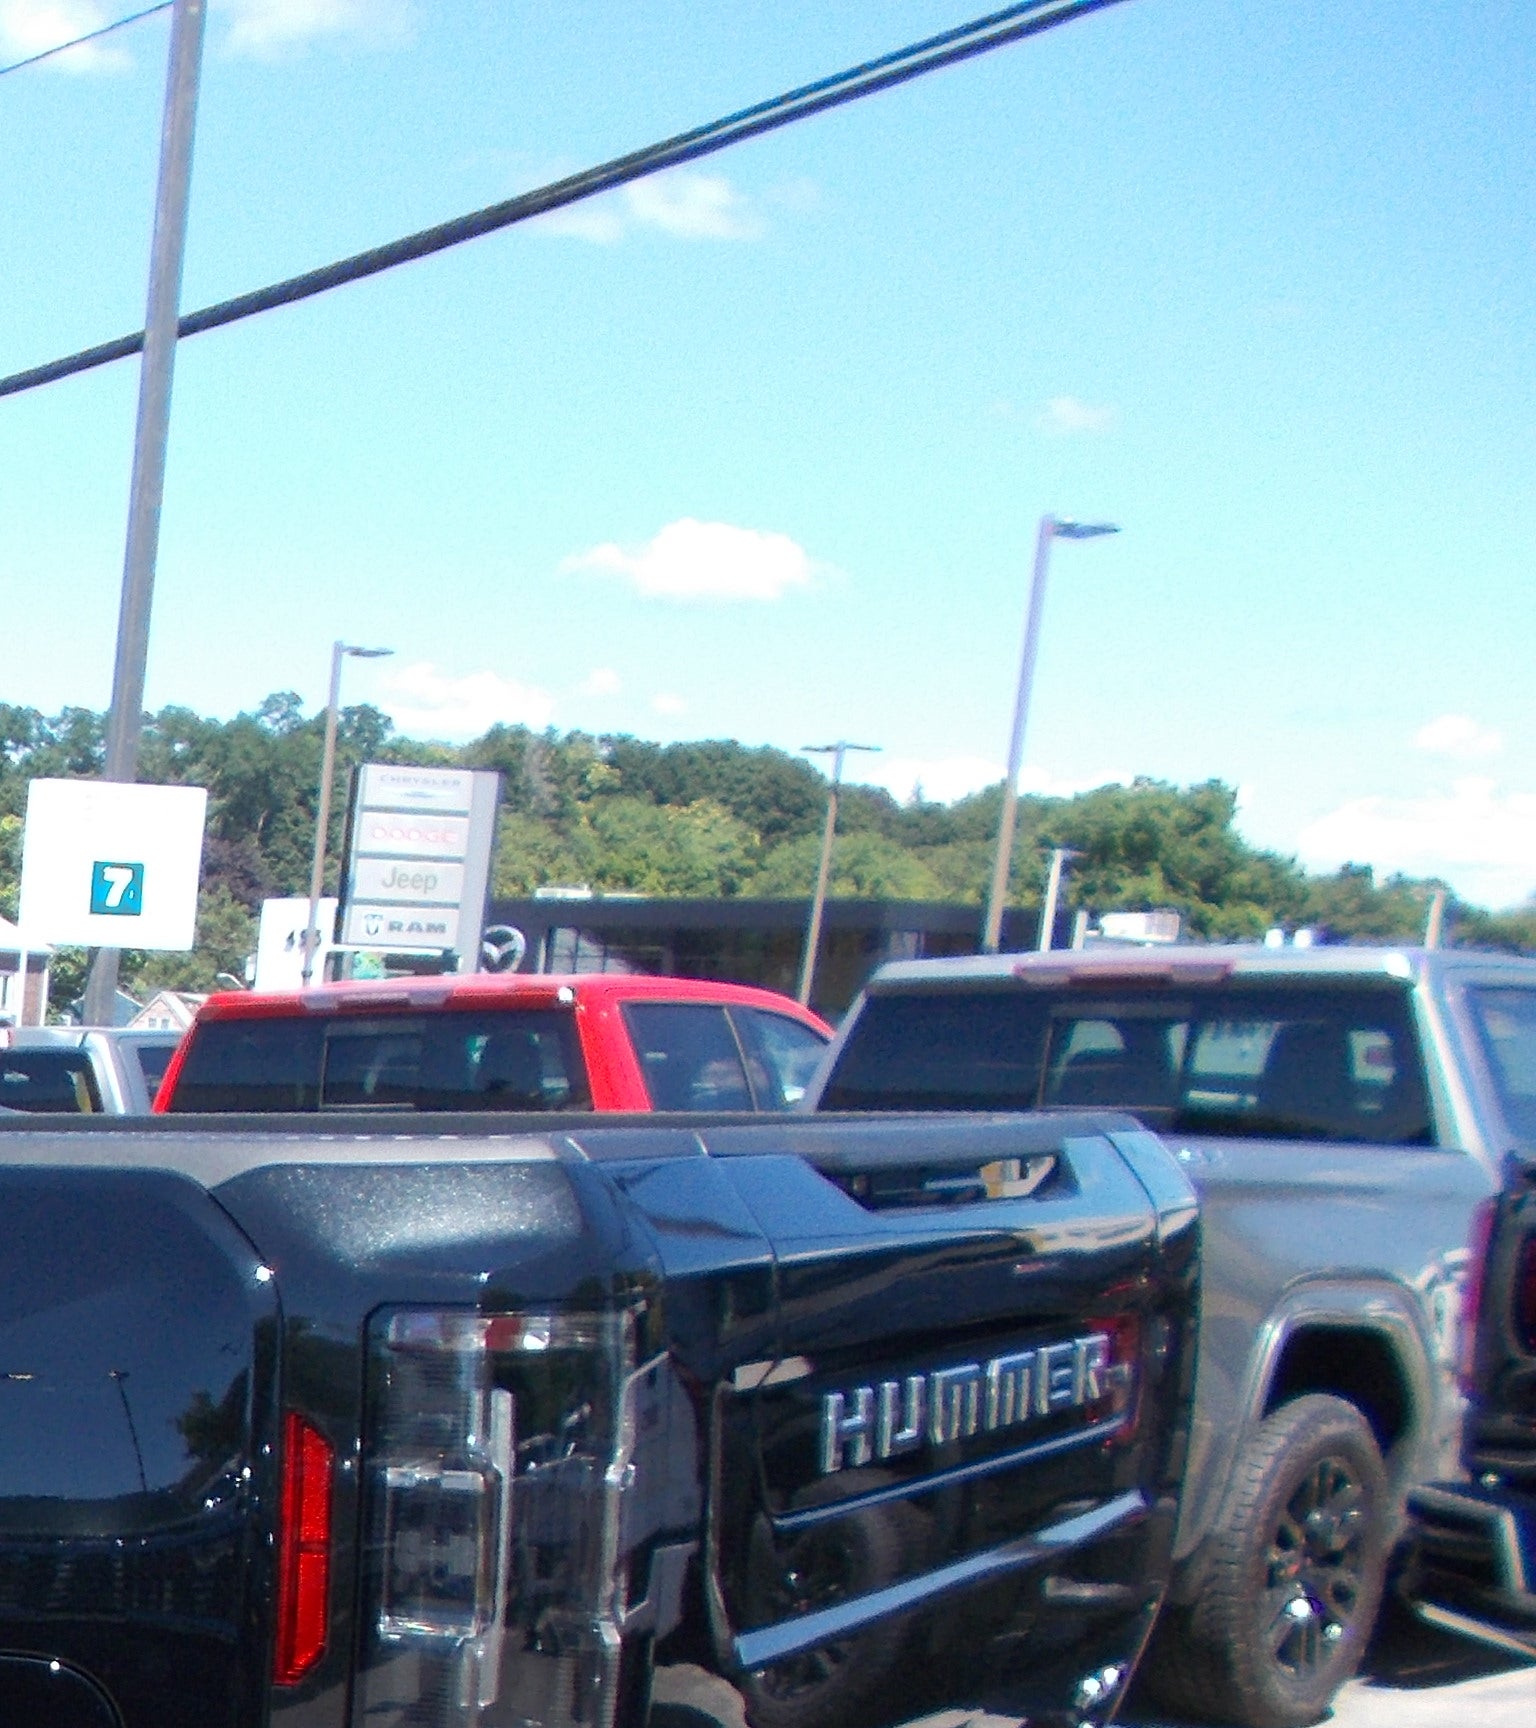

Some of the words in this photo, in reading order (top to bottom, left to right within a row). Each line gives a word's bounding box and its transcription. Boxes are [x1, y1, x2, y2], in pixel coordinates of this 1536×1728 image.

[379, 773, 462, 787] CHRYSLER
[372, 826, 458, 843] DODGE
[381, 866, 439, 895] Jeep
[388, 920, 447, 934] RAM
[821, 1333, 1110, 1473] HUMMER
